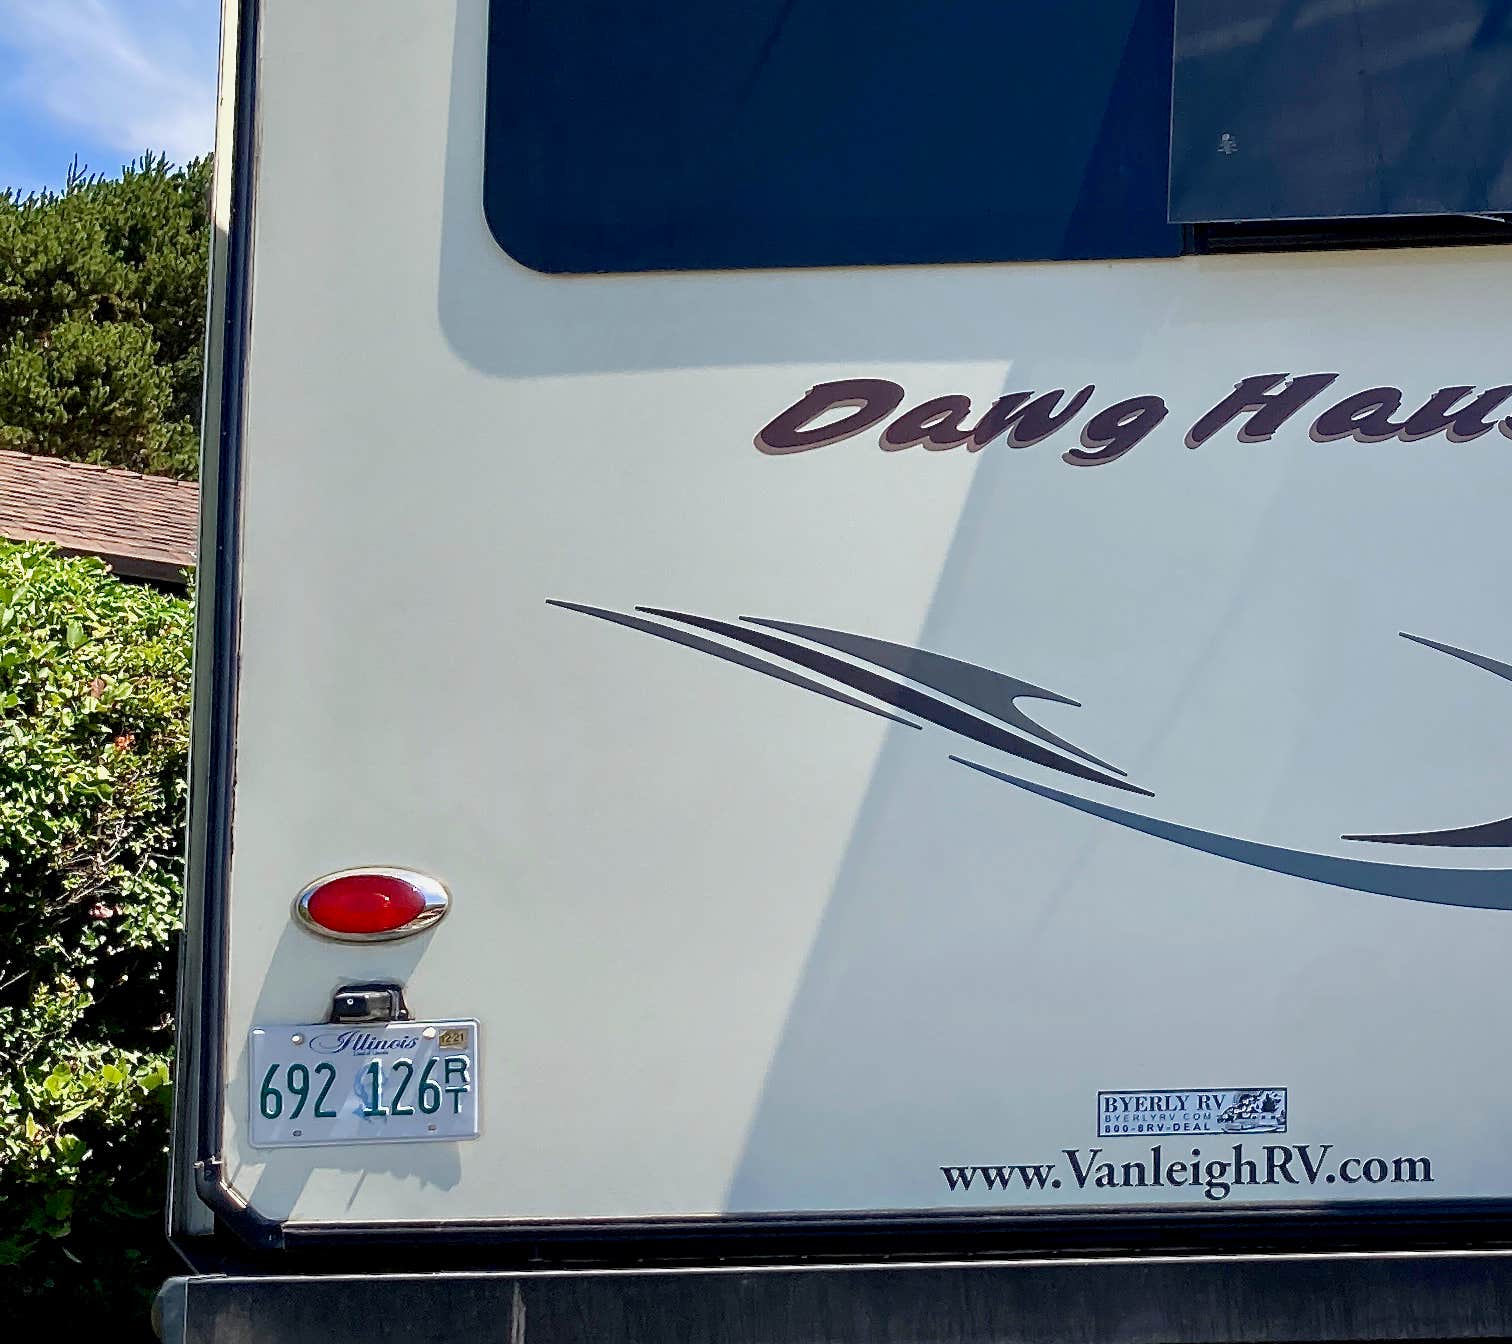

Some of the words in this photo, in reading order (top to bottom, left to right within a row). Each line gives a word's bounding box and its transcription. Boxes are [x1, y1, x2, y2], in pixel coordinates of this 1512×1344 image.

[753, 378, 1169, 467] Dawg
[309, 1030, 419, 1054] Illinois
[260, 1062, 337, 1120] 692
[362, 1057, 442, 1116] 126
[1104, 1095, 1190, 1113] BYERLY
[1197, 1093, 1226, 1110] RV
[1104, 1122, 1211, 1133] 800-8RV-DEAL
[939, 1144, 1435, 1200] www.VanleighRV.com
